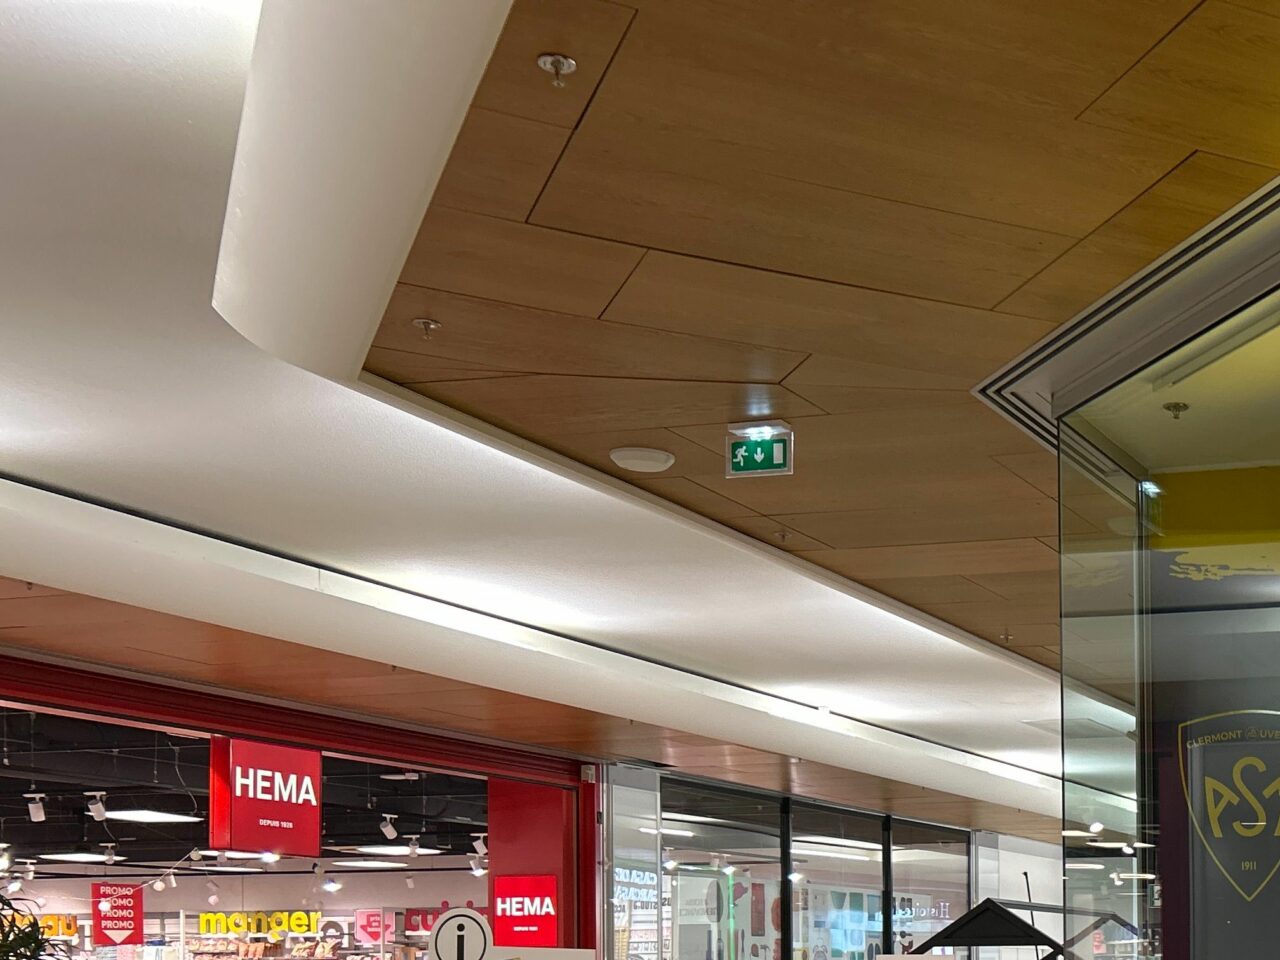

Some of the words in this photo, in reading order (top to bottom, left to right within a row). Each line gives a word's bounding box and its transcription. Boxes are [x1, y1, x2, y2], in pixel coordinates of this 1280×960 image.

[1186, 730, 1243, 749] CLERMONT
[235, 766, 318, 806] HEMA
[259, 818, 280, 828] DEPUIS
[1241, 861, 1257, 871] 1911
[100, 886, 134, 895] PROMO
[496, 896, 555, 917] HEMA
[101, 920, 135, 929] PROMO
[199, 911, 322, 941] manger
